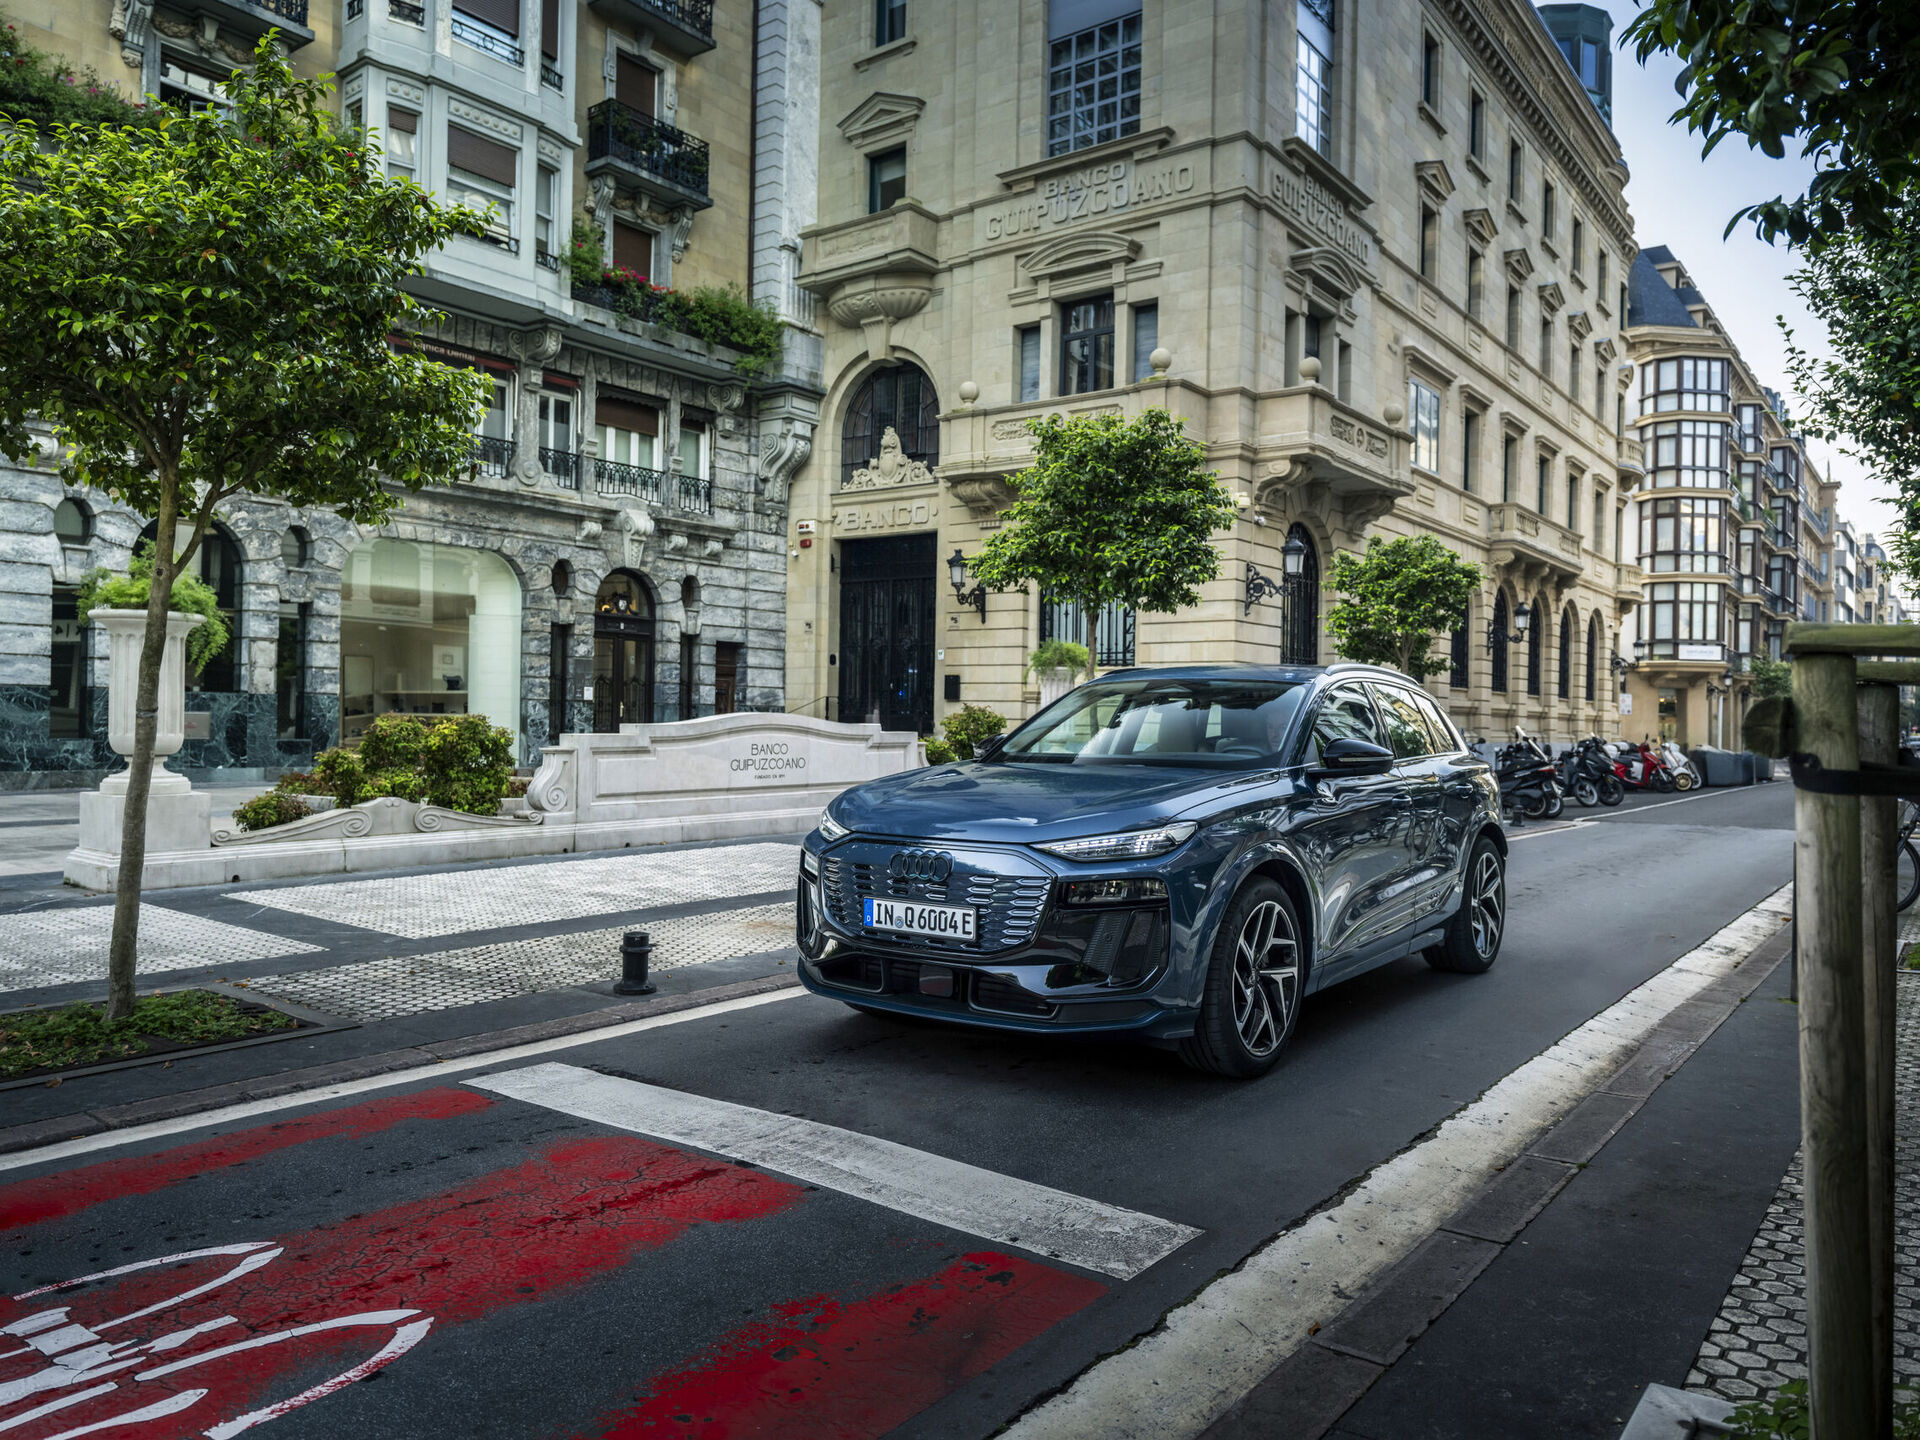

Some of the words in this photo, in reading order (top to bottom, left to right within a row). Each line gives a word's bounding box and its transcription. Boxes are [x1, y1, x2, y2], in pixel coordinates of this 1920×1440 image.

[1044, 160, 1127, 199] BANCO
[1305, 175, 1344, 219] BANCO
[986, 164, 1195, 241] GUIPUZCOANO
[1272, 171, 1369, 265] GUIPUZCOANO
[843, 500, 930, 531] BANCO
[730, 757, 807, 771] GUIPUZCOANO
[751, 743, 789, 756] BANCO
[875, 903, 894, 926] IN
